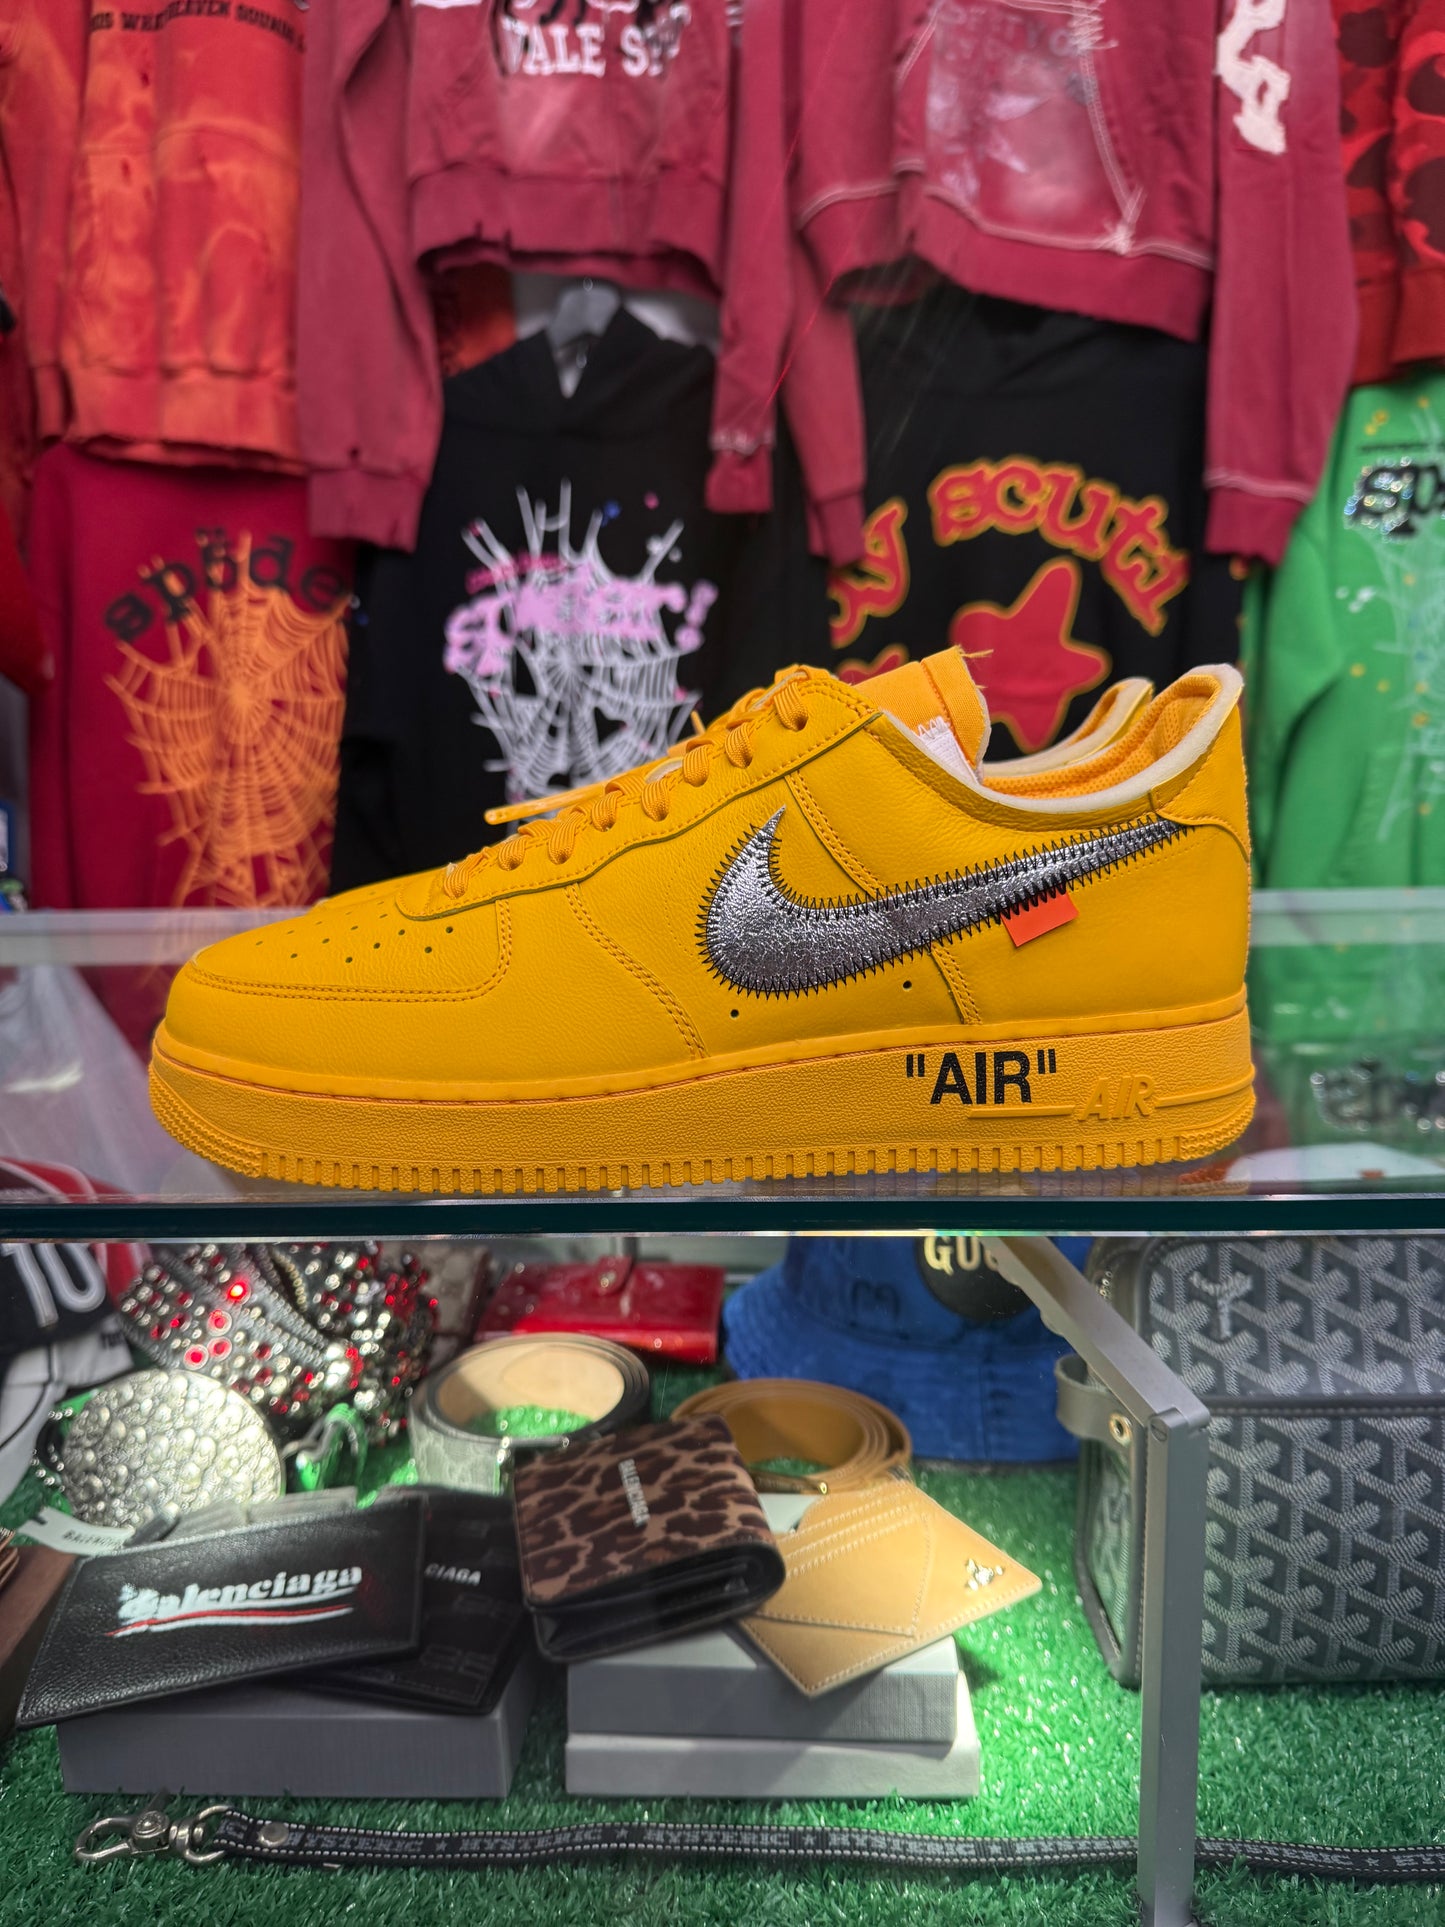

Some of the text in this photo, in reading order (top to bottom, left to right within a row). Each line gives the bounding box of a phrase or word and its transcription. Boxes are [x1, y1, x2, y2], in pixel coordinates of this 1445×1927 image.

[501, 16, 606, 77] VALE
[906, 1048, 1057, 1105] "AIR"
[1077, 1074, 1154, 1122] AIR
